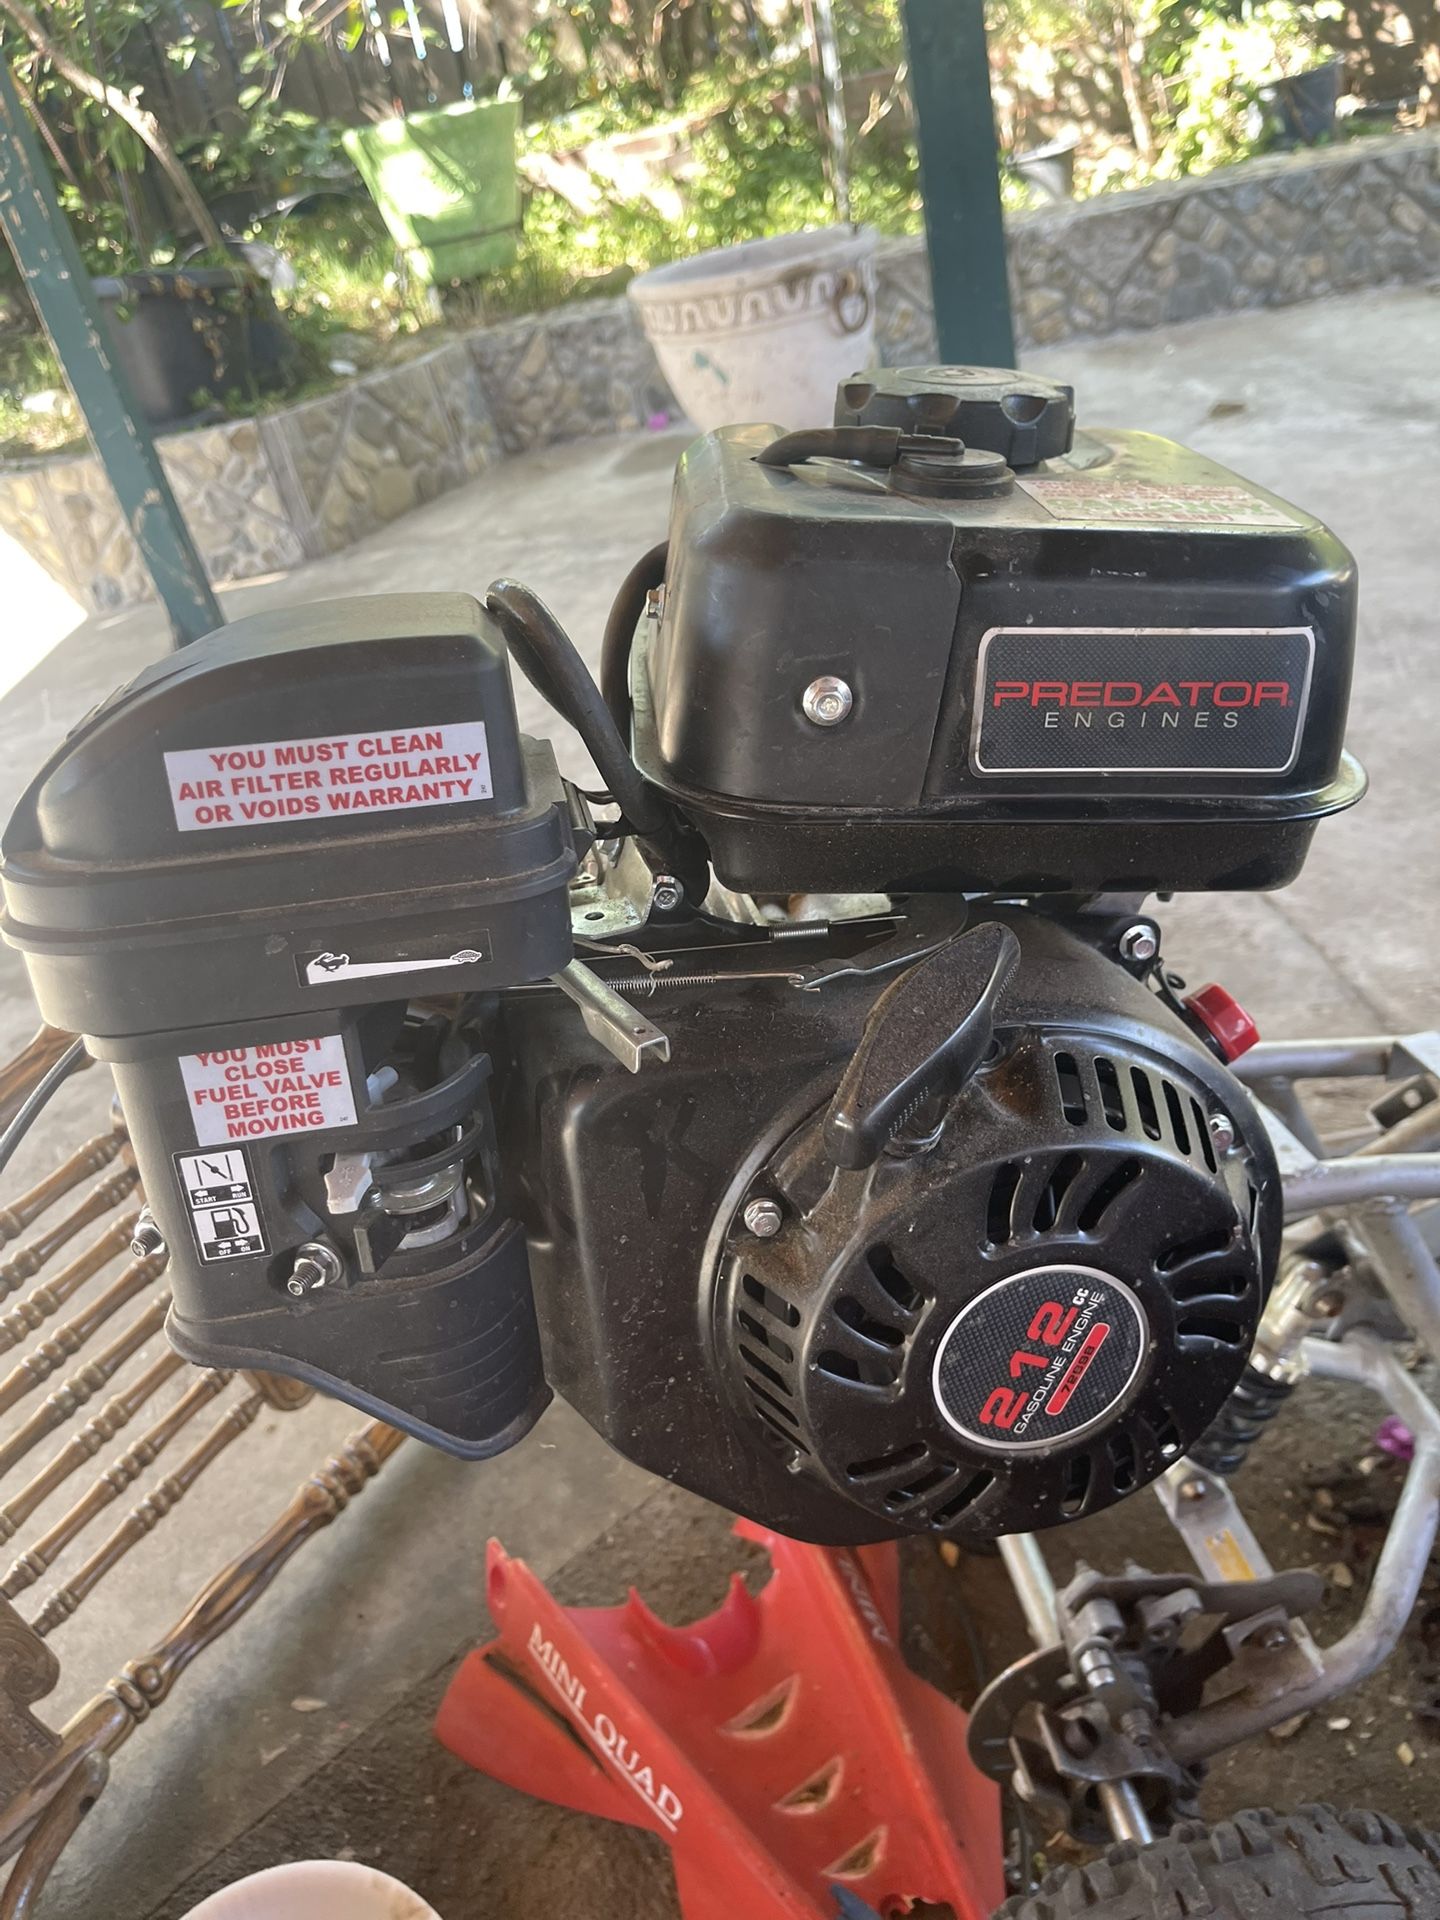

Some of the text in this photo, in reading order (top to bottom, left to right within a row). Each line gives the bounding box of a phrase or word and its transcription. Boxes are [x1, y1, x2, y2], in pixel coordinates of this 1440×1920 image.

[993, 681, 1292, 708] PREDATOR
[1044, 711, 1239, 728] ENGINES
[209, 732, 444, 771] YOU MUST CLEAN
[178, 753, 482, 801] AIR FILTER REGULARLY
[194, 778, 474, 824] OR VOIDS WARRANTY
[195, 1037, 325, 1067] YOU MUST
[224, 1057, 306, 1082] CLOSE
[194, 1071, 342, 1105] FUEL VALVE
[224, 1092, 321, 1120] BEFORE
[227, 1110, 325, 1138] MOVING
[195, 1191, 247, 1205] START RUN
[218, 1245, 251, 1256] OFF ON
[979, 1301, 1079, 1429] 212
[1013, 1291, 1104, 1434] GASOLINE ENGINE
[528, 1622, 683, 1821] MINI QUAD
